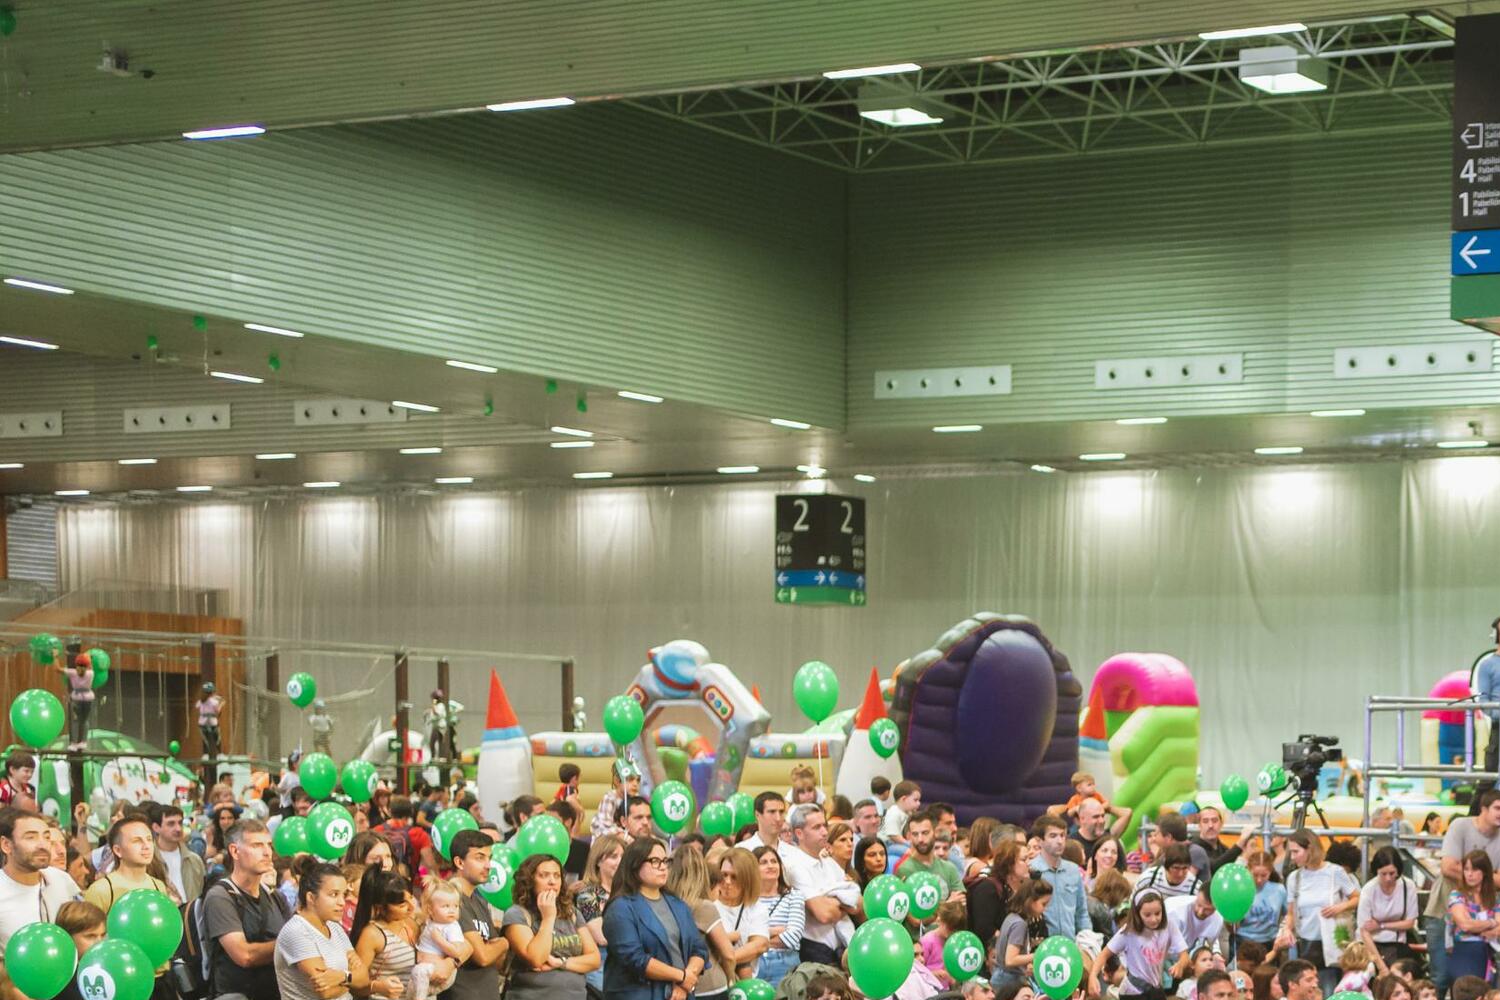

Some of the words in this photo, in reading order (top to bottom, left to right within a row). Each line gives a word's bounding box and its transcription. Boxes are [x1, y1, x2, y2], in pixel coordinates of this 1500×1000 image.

[1459, 158, 1477, 183] 4
[1459, 192, 1469, 217] 1
[793, 499, 810, 531] 2
[840, 501, 853, 533] 2
